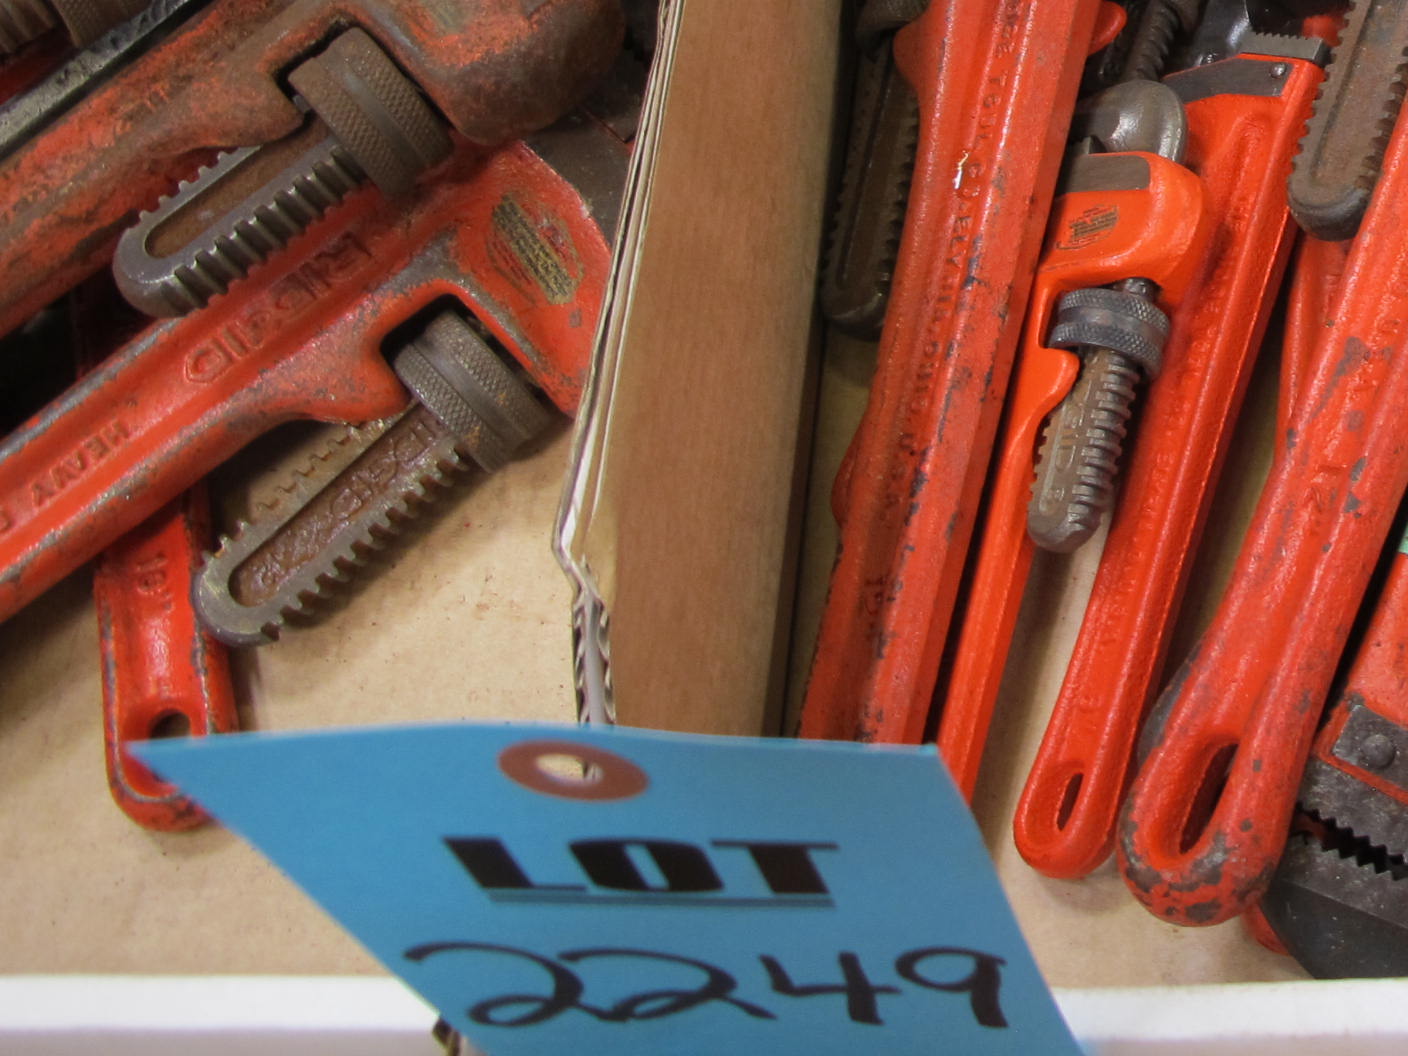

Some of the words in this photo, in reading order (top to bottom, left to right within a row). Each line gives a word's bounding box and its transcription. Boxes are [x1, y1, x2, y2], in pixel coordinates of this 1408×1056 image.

[27, 420, 131, 509] HEAVY
[443, 836, 841, 896] LOT
[403, 941, 1010, 1028] 2249
